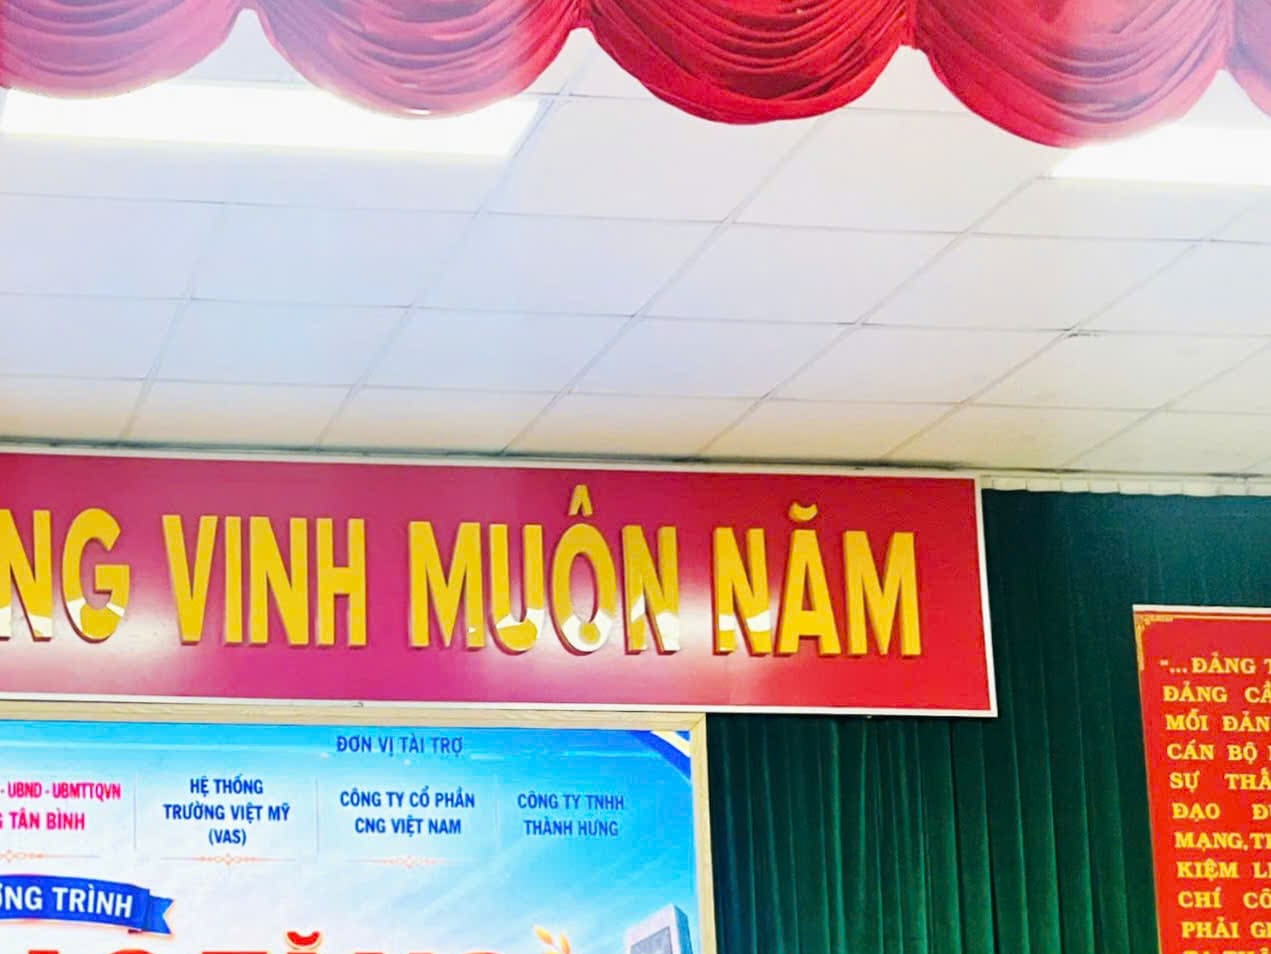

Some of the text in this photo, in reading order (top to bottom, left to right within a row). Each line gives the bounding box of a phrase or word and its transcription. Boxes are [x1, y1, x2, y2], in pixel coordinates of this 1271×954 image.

[162, 514, 367, 647] VINH
[408, 484, 681, 655] MUÔN
[713, 501, 922, 657] NĂM
[1163, 681, 1228, 703] ĐẢNG
[1165, 708, 1271, 732] MỖI ĐẢN
[337, 733, 463, 757] ĐƠN VỊ TÀI TRỢ
[1167, 739, 1215, 760] CÁN
[1227, 742, 1258, 765] BỘ
[8, 781, 42, 798] UBND
[190, 773, 264, 797] HỆ THỐNG
[1169, 770, 1201, 793] SỰ
[340, 785, 475, 808] CÔNG TY CỔ PHẦN
[518, 790, 625, 811] CÔNG TY TNHH
[9, 808, 40, 830] TÂN
[47, 808, 85, 830] BÌNH
[163, 801, 290, 824] TRƯỜNG VIỆT MỸ
[1172, 802, 1221, 822] ĐẠO
[208, 828, 247, 846] (VAS)
[355, 814, 461, 837] CNG VIỆT NAM
[523, 815, 573, 836] THÀNH
[1174, 831, 1248, 851] MẠNG,
[1176, 858, 1240, 882] KIỆM
[52, 884, 133, 918] TRÌNH
[1178, 886, 1223, 909] CHÍ
[1181, 916, 1240, 938] PHẢI
